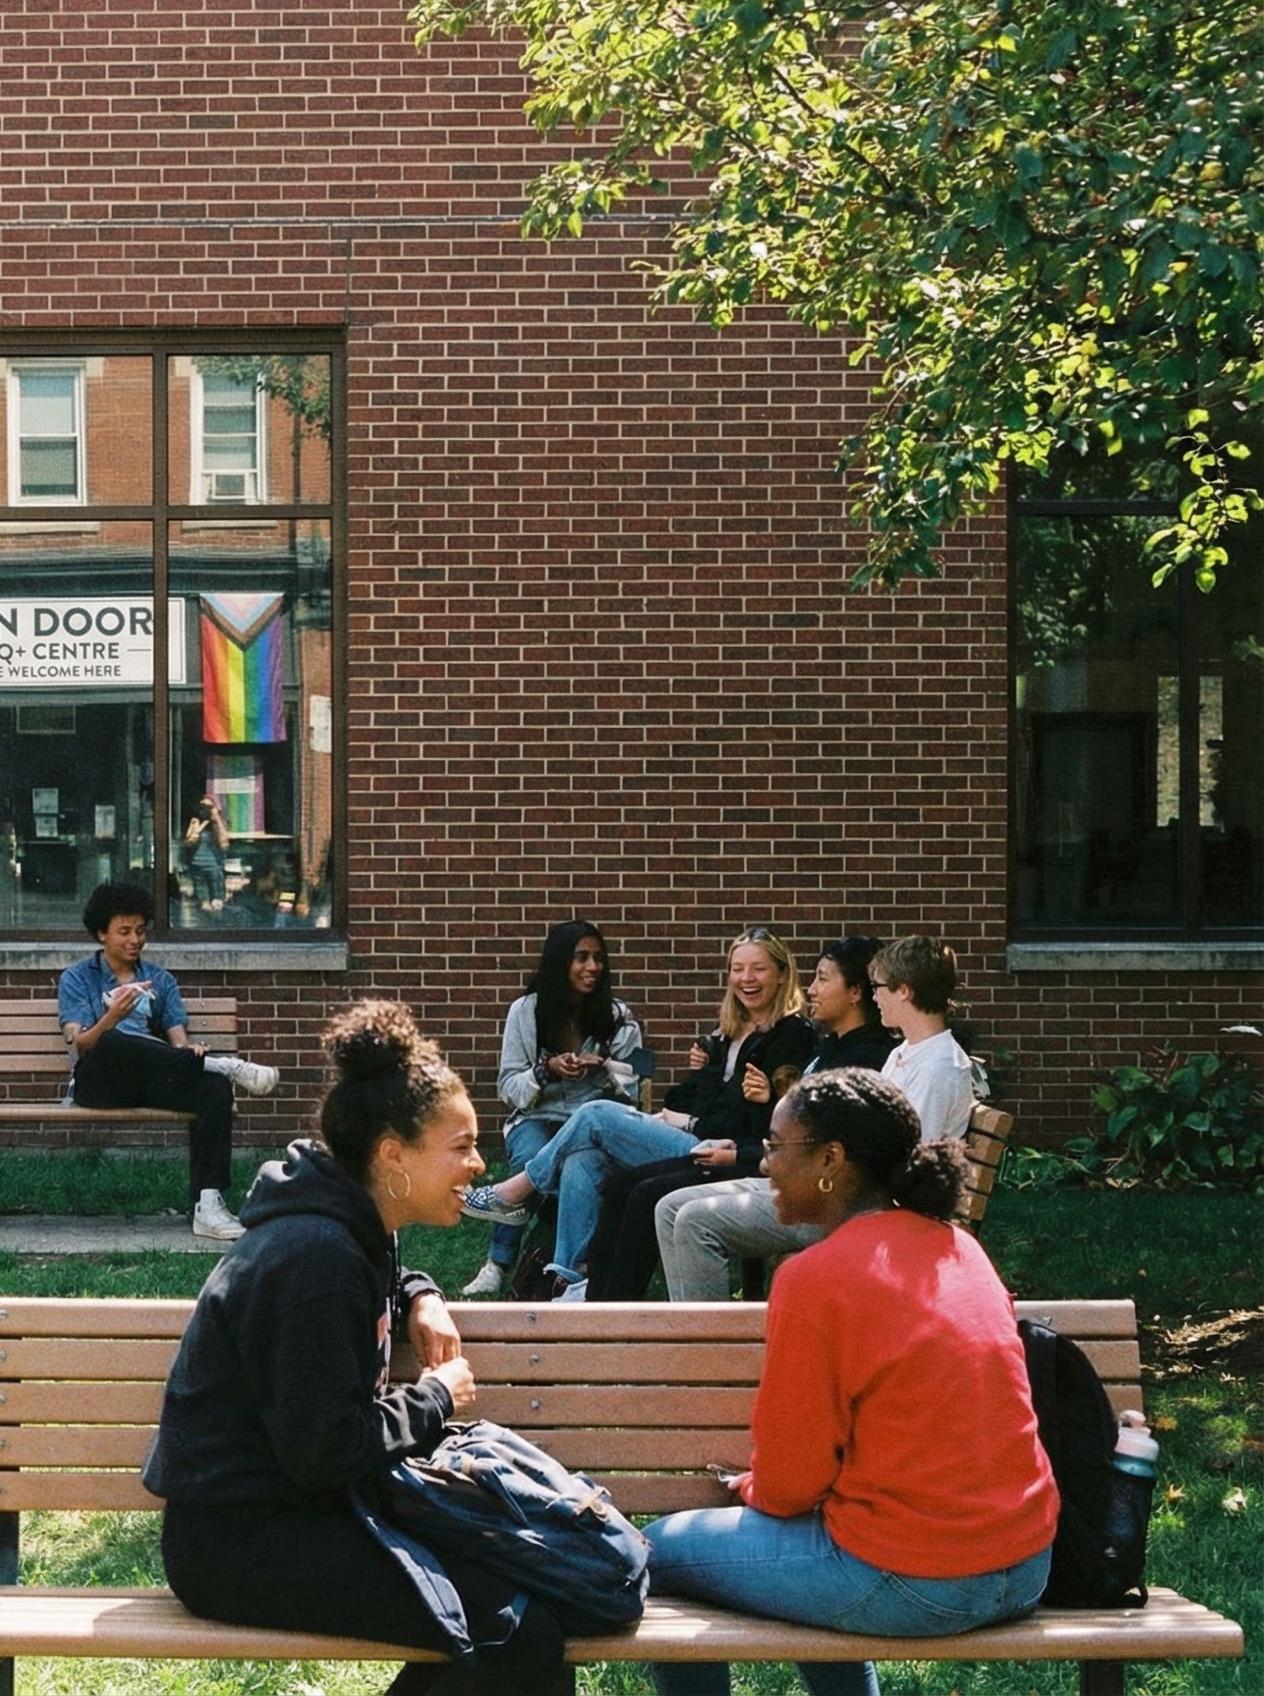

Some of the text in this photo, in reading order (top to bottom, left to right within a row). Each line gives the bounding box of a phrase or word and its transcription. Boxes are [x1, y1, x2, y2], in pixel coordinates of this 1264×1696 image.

[33, 607, 153, 637] DOOR
[32, 642, 120, 660] CENTRE
[7, 665, 80, 678] WELCOME
[83, 665, 121, 677] HERE
